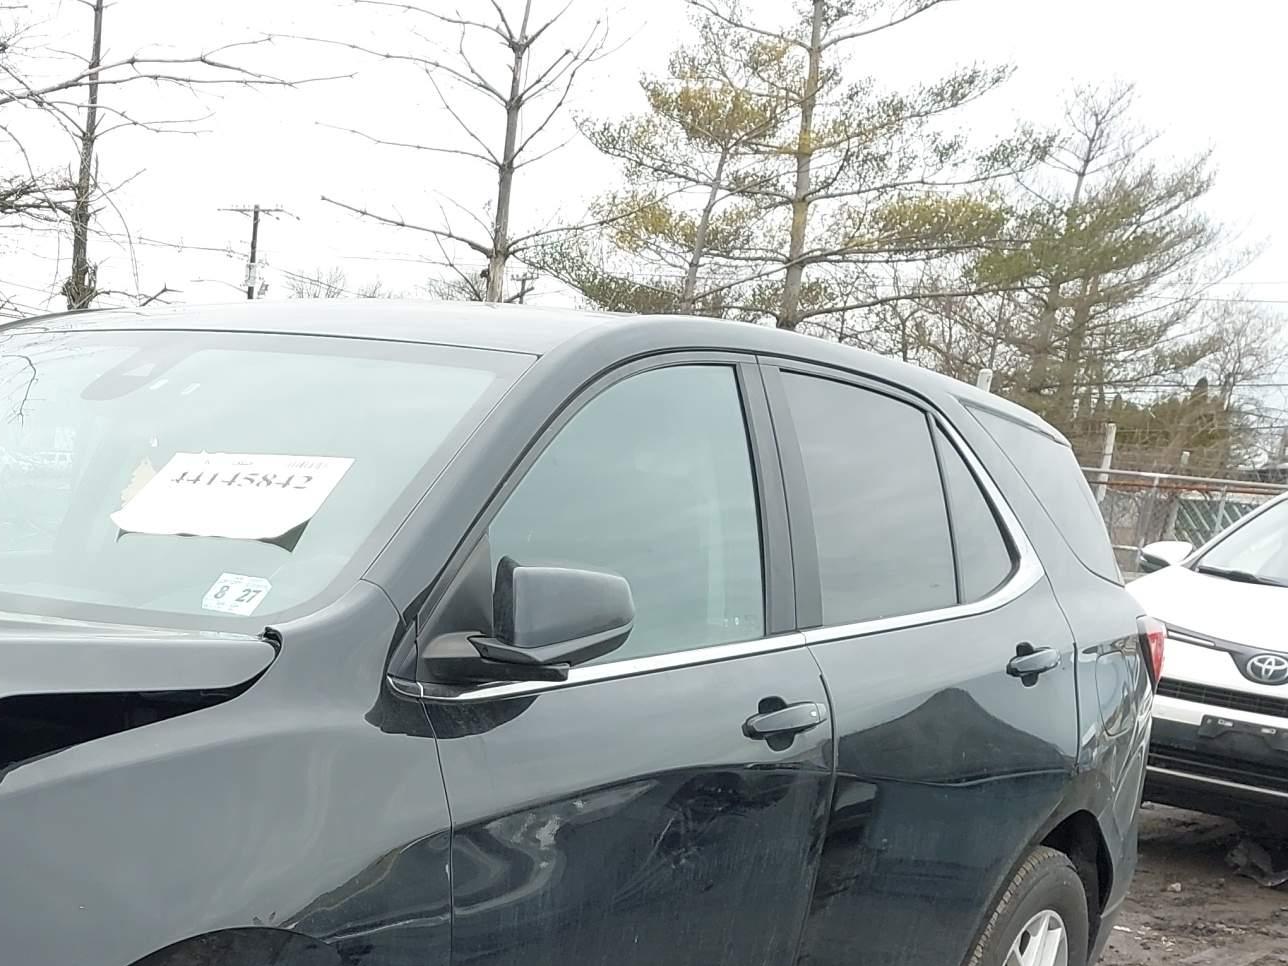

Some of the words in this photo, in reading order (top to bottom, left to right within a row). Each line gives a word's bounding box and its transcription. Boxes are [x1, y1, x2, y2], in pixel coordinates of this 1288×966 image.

[170, 471, 314, 489] 44145842
[213, 585, 230, 600] 8
[234, 588, 262, 603] 27
